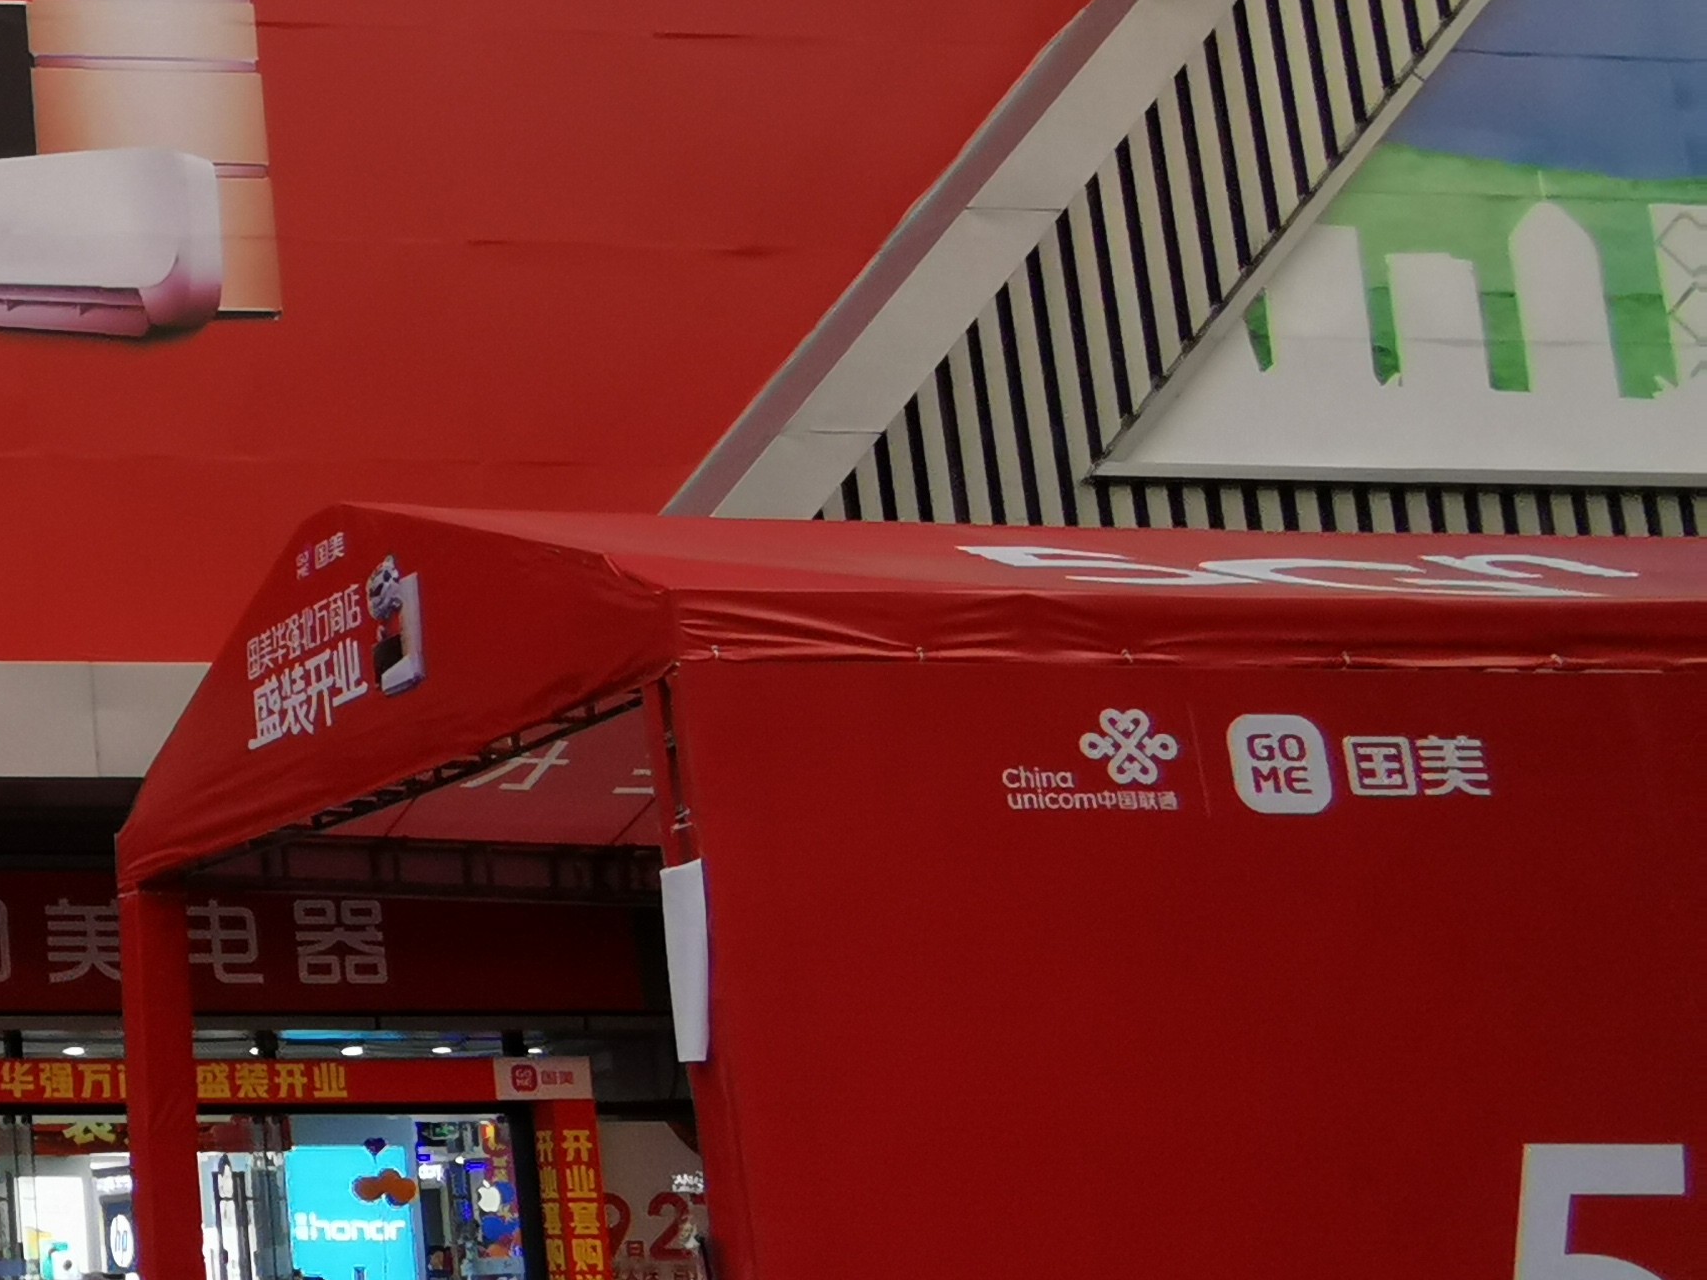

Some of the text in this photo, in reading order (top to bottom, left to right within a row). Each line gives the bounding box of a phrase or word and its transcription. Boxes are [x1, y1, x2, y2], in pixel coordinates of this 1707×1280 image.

[315, 531, 345, 570] 国美
[247, 583, 363, 680] 国美华强北万商店
[248, 637, 368, 751] 盛装开业
[1001, 765, 1075, 789] China
[1344, 733, 1493, 798] 国美
